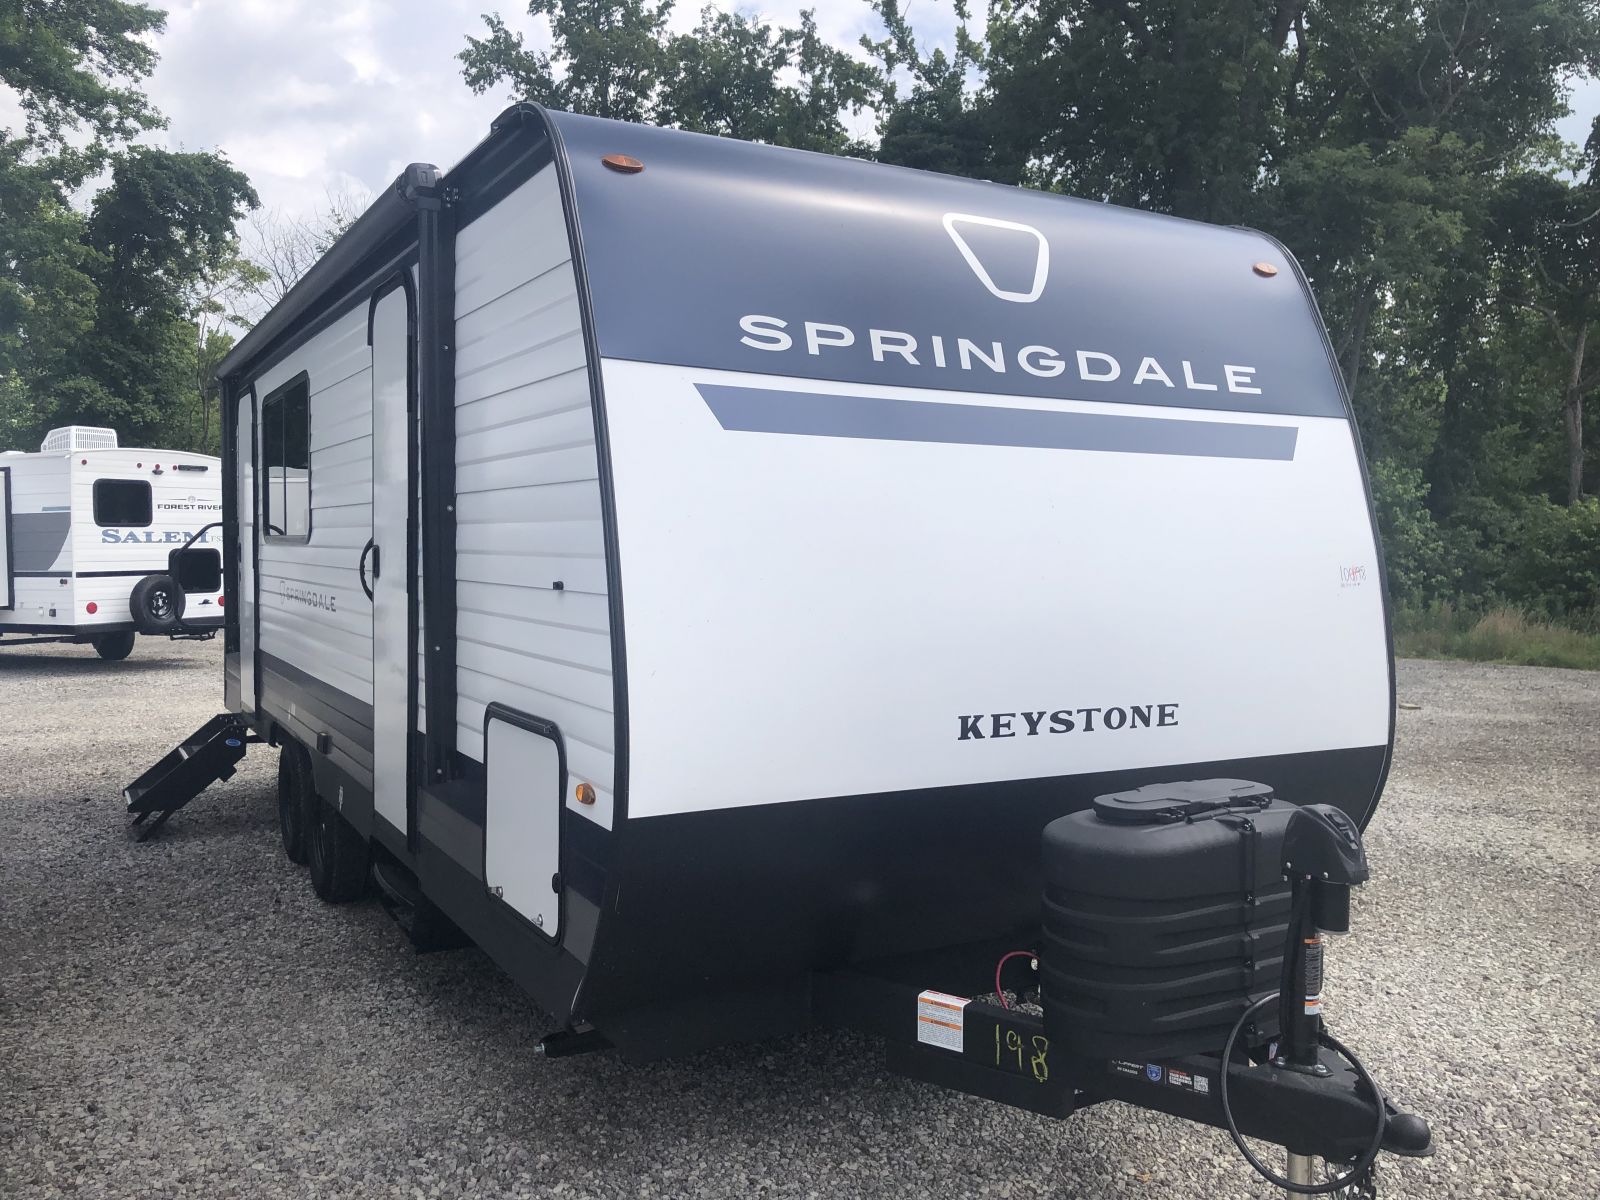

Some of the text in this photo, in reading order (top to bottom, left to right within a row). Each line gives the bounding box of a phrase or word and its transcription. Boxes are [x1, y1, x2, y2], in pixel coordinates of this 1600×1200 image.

[739, 314, 1263, 396] SPRINGDALE
[101, 528, 209, 544] SALEM
[285, 586, 337, 612] SPRINGDALE
[957, 703, 1179, 741] KEYSTONE
[995, 1024, 1048, 1082] 198
